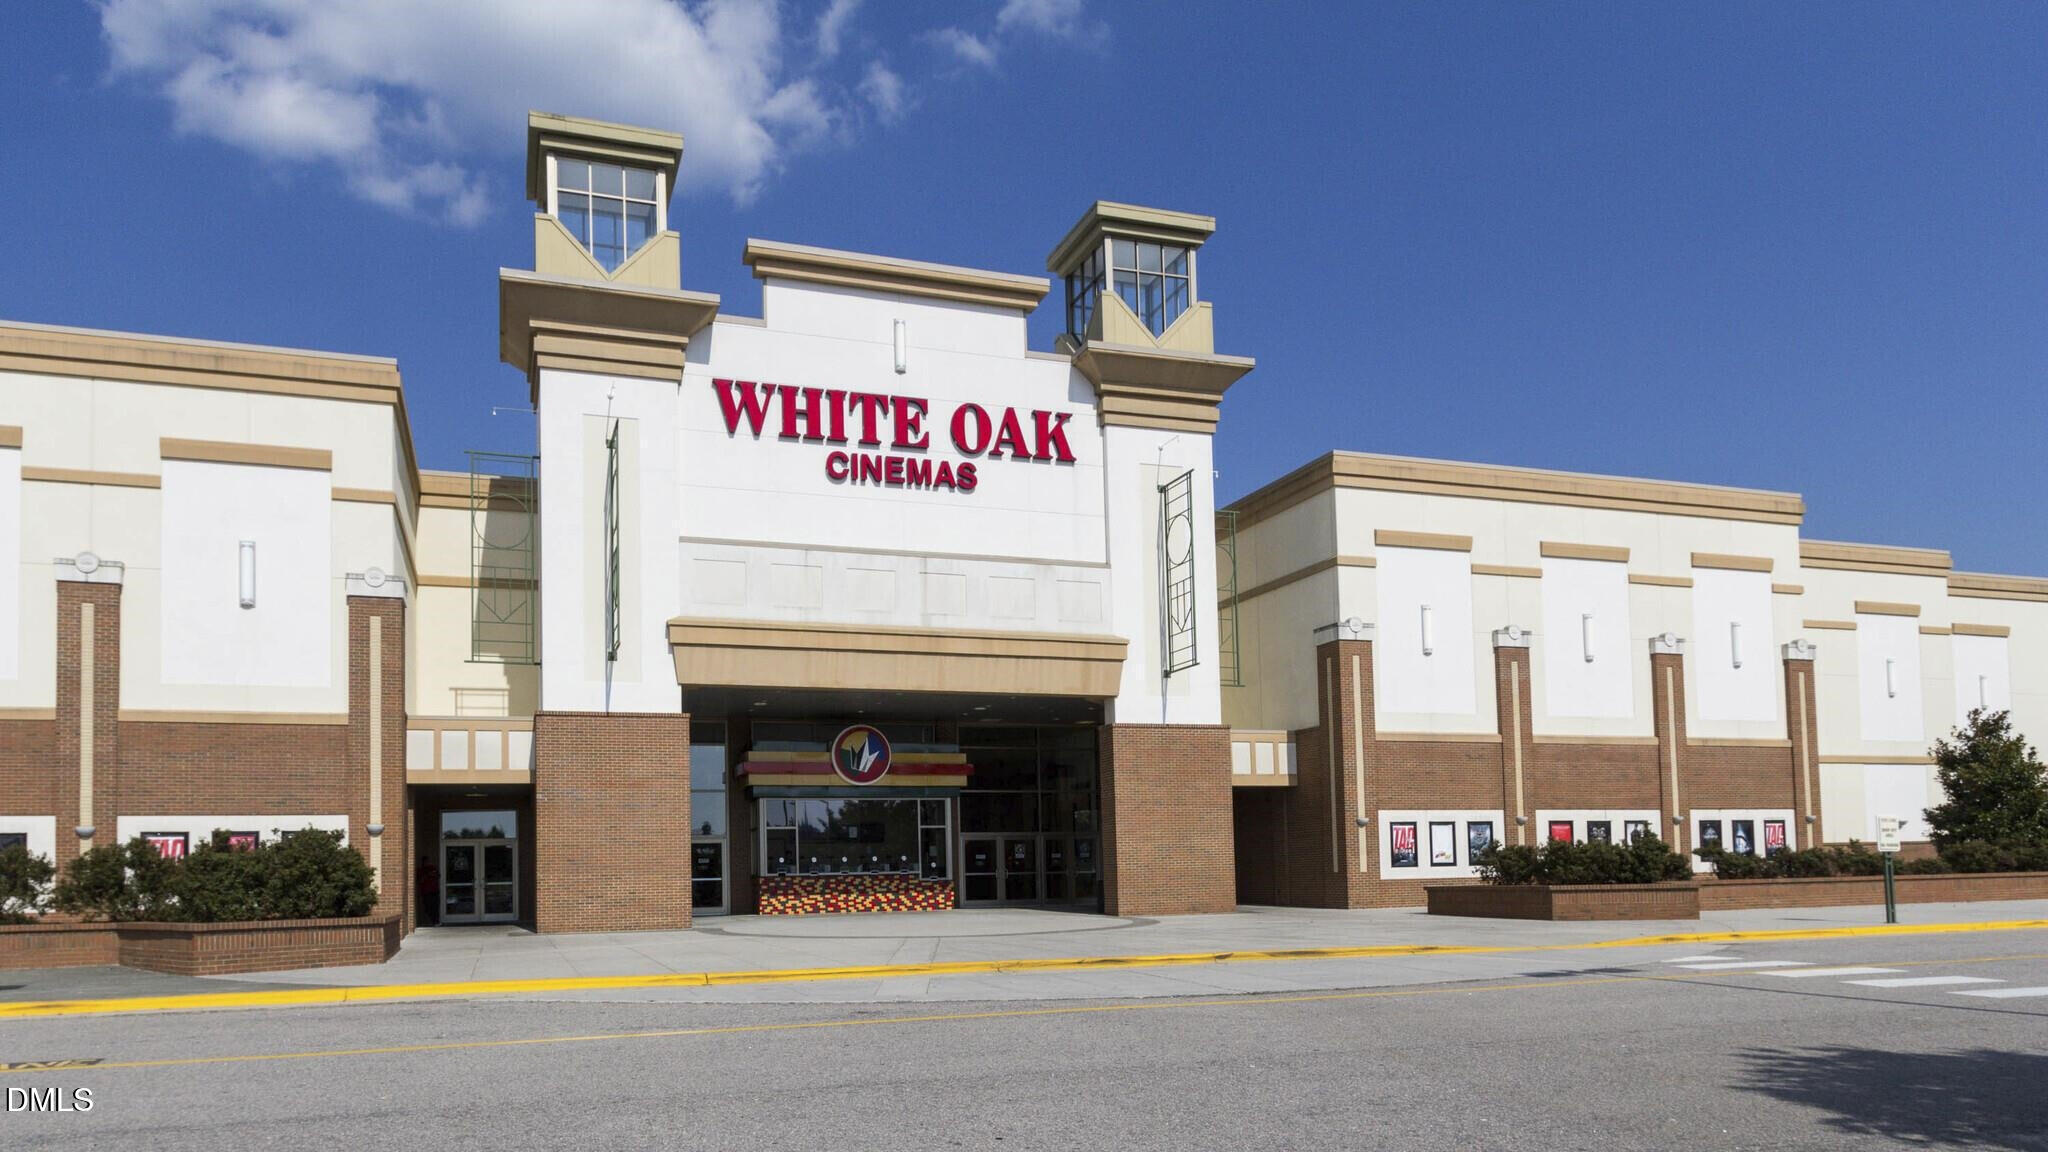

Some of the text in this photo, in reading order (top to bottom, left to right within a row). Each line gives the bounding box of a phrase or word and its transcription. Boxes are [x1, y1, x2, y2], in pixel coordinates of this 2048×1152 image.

[712, 377, 1077, 463] WHITE OAK
[825, 450, 979, 490] CINEMAS
